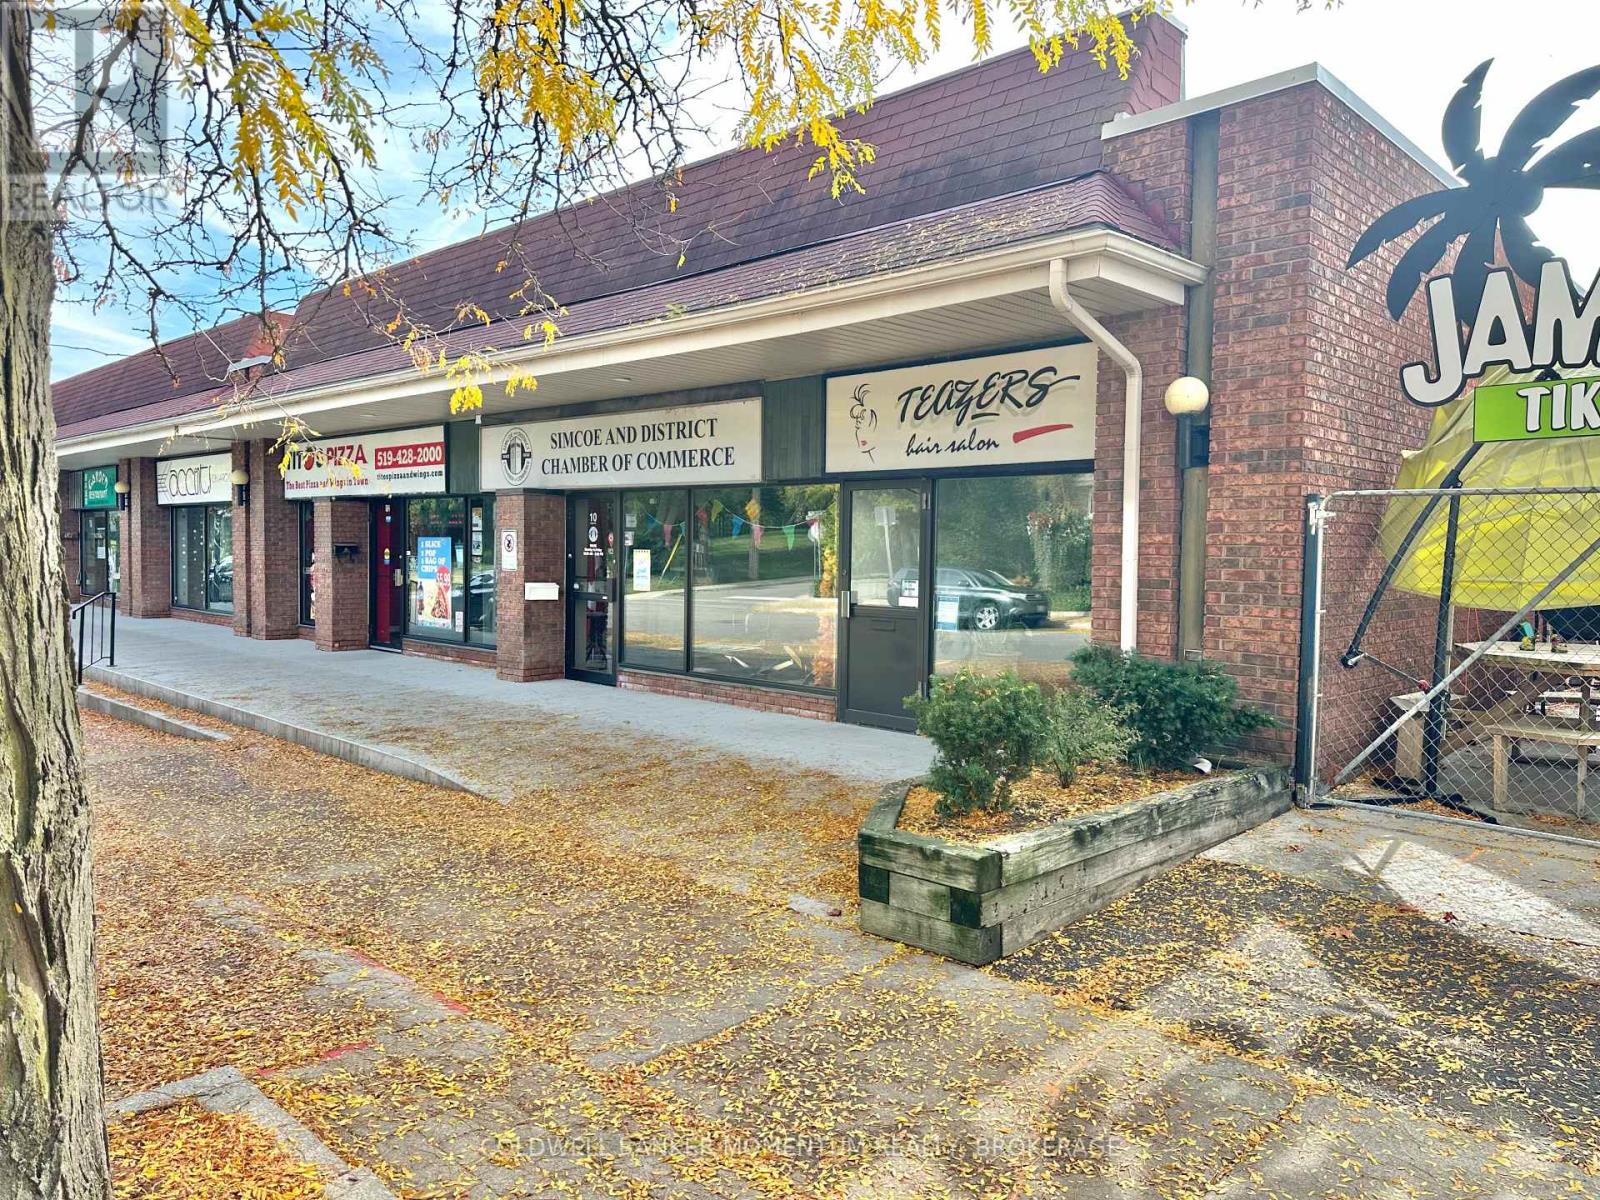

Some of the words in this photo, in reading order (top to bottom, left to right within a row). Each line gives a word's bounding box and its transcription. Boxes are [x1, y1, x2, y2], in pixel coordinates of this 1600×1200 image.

[898, 366, 1081, 427] TEAZERS
[550, 428, 602, 450] SIMCOE
[605, 425, 637, 446] AND
[641, 417, 719, 443] DISTRICT
[905, 433, 942, 457] hair
[944, 428, 1000, 454] salon
[377, 445, 443, 467] 519-428-2000
[541, 455, 609, 475] CHAMBER
[611, 453, 633, 472] OF
[636, 446, 735, 470] COMMERCE
[589, 512, 598, 522] 10
